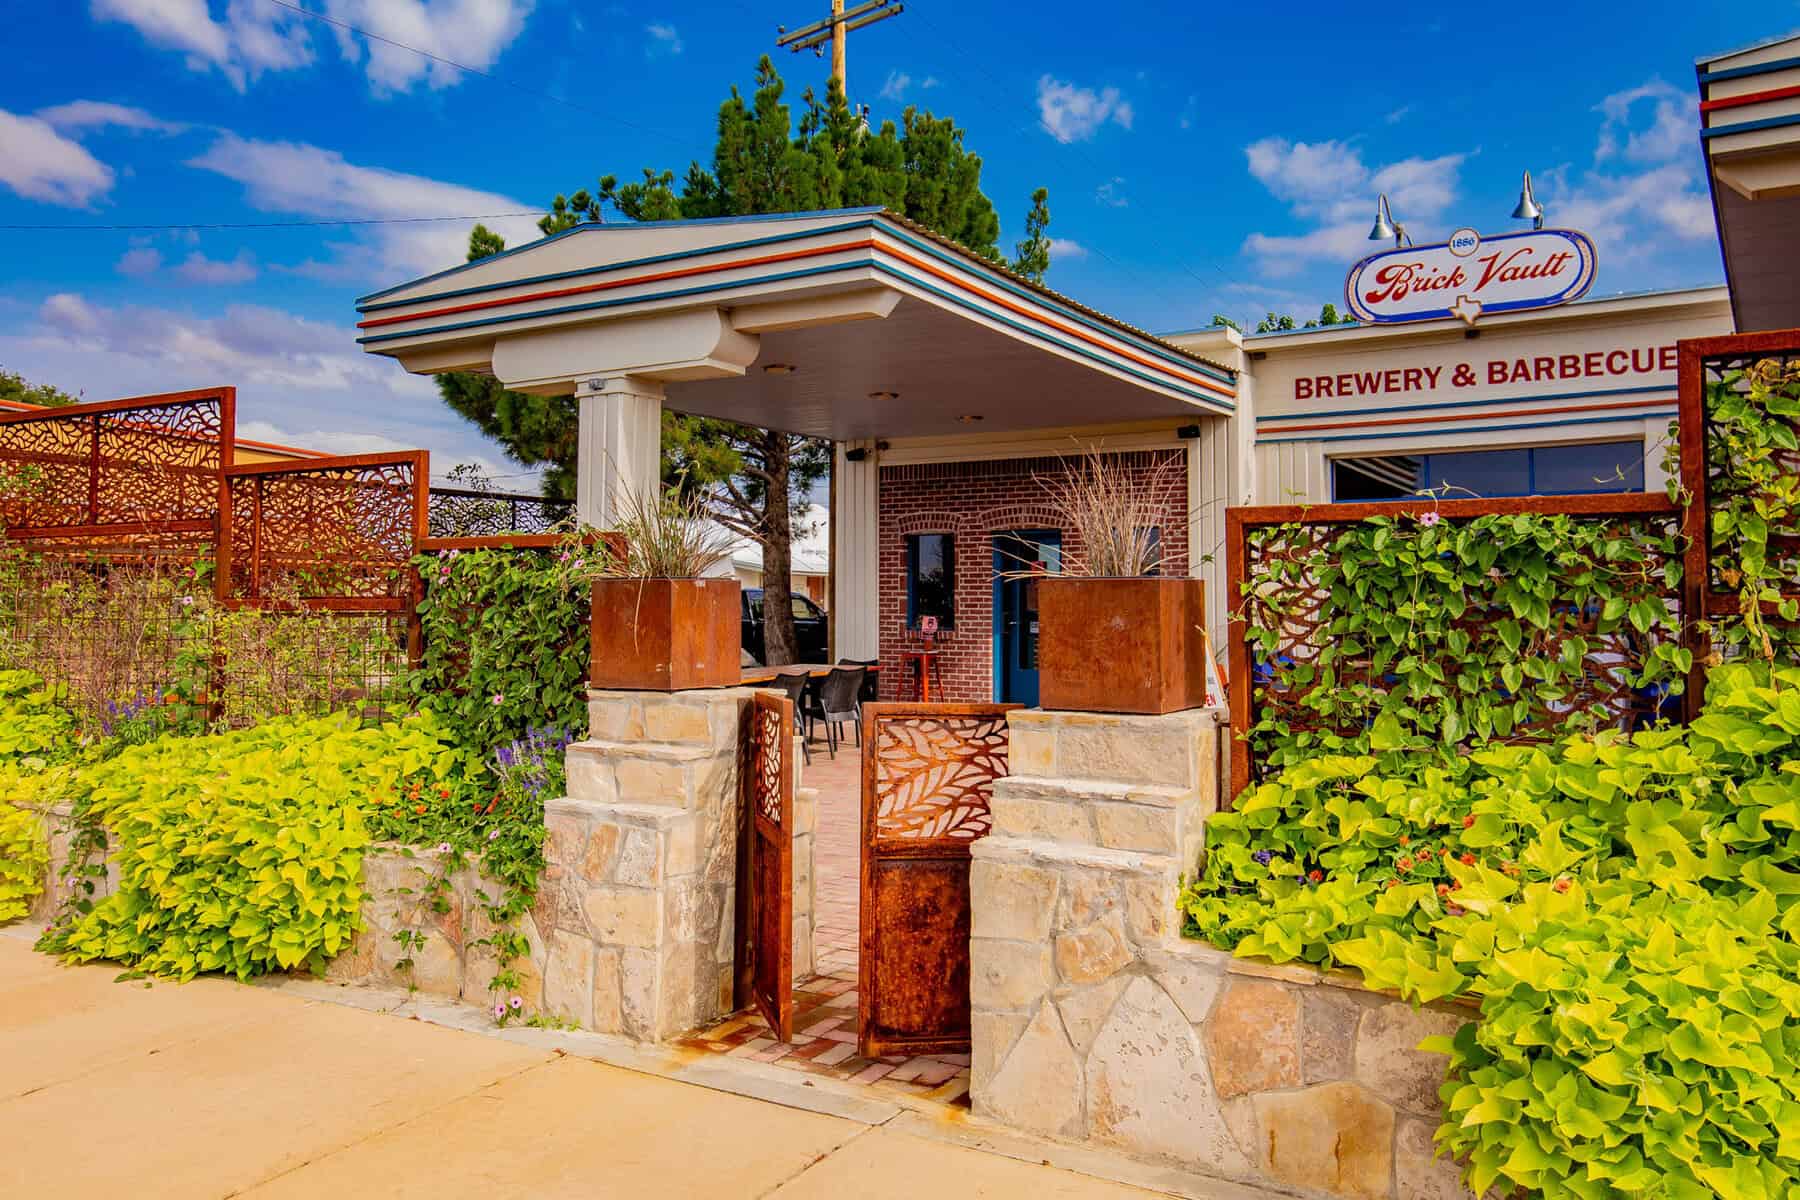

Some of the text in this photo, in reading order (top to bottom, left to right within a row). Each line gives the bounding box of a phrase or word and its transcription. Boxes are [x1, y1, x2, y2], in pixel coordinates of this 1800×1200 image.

[1365, 247, 1573, 304] Brick Vault
[1295, 346, 1678, 400] BREWERY & BARBECUE
